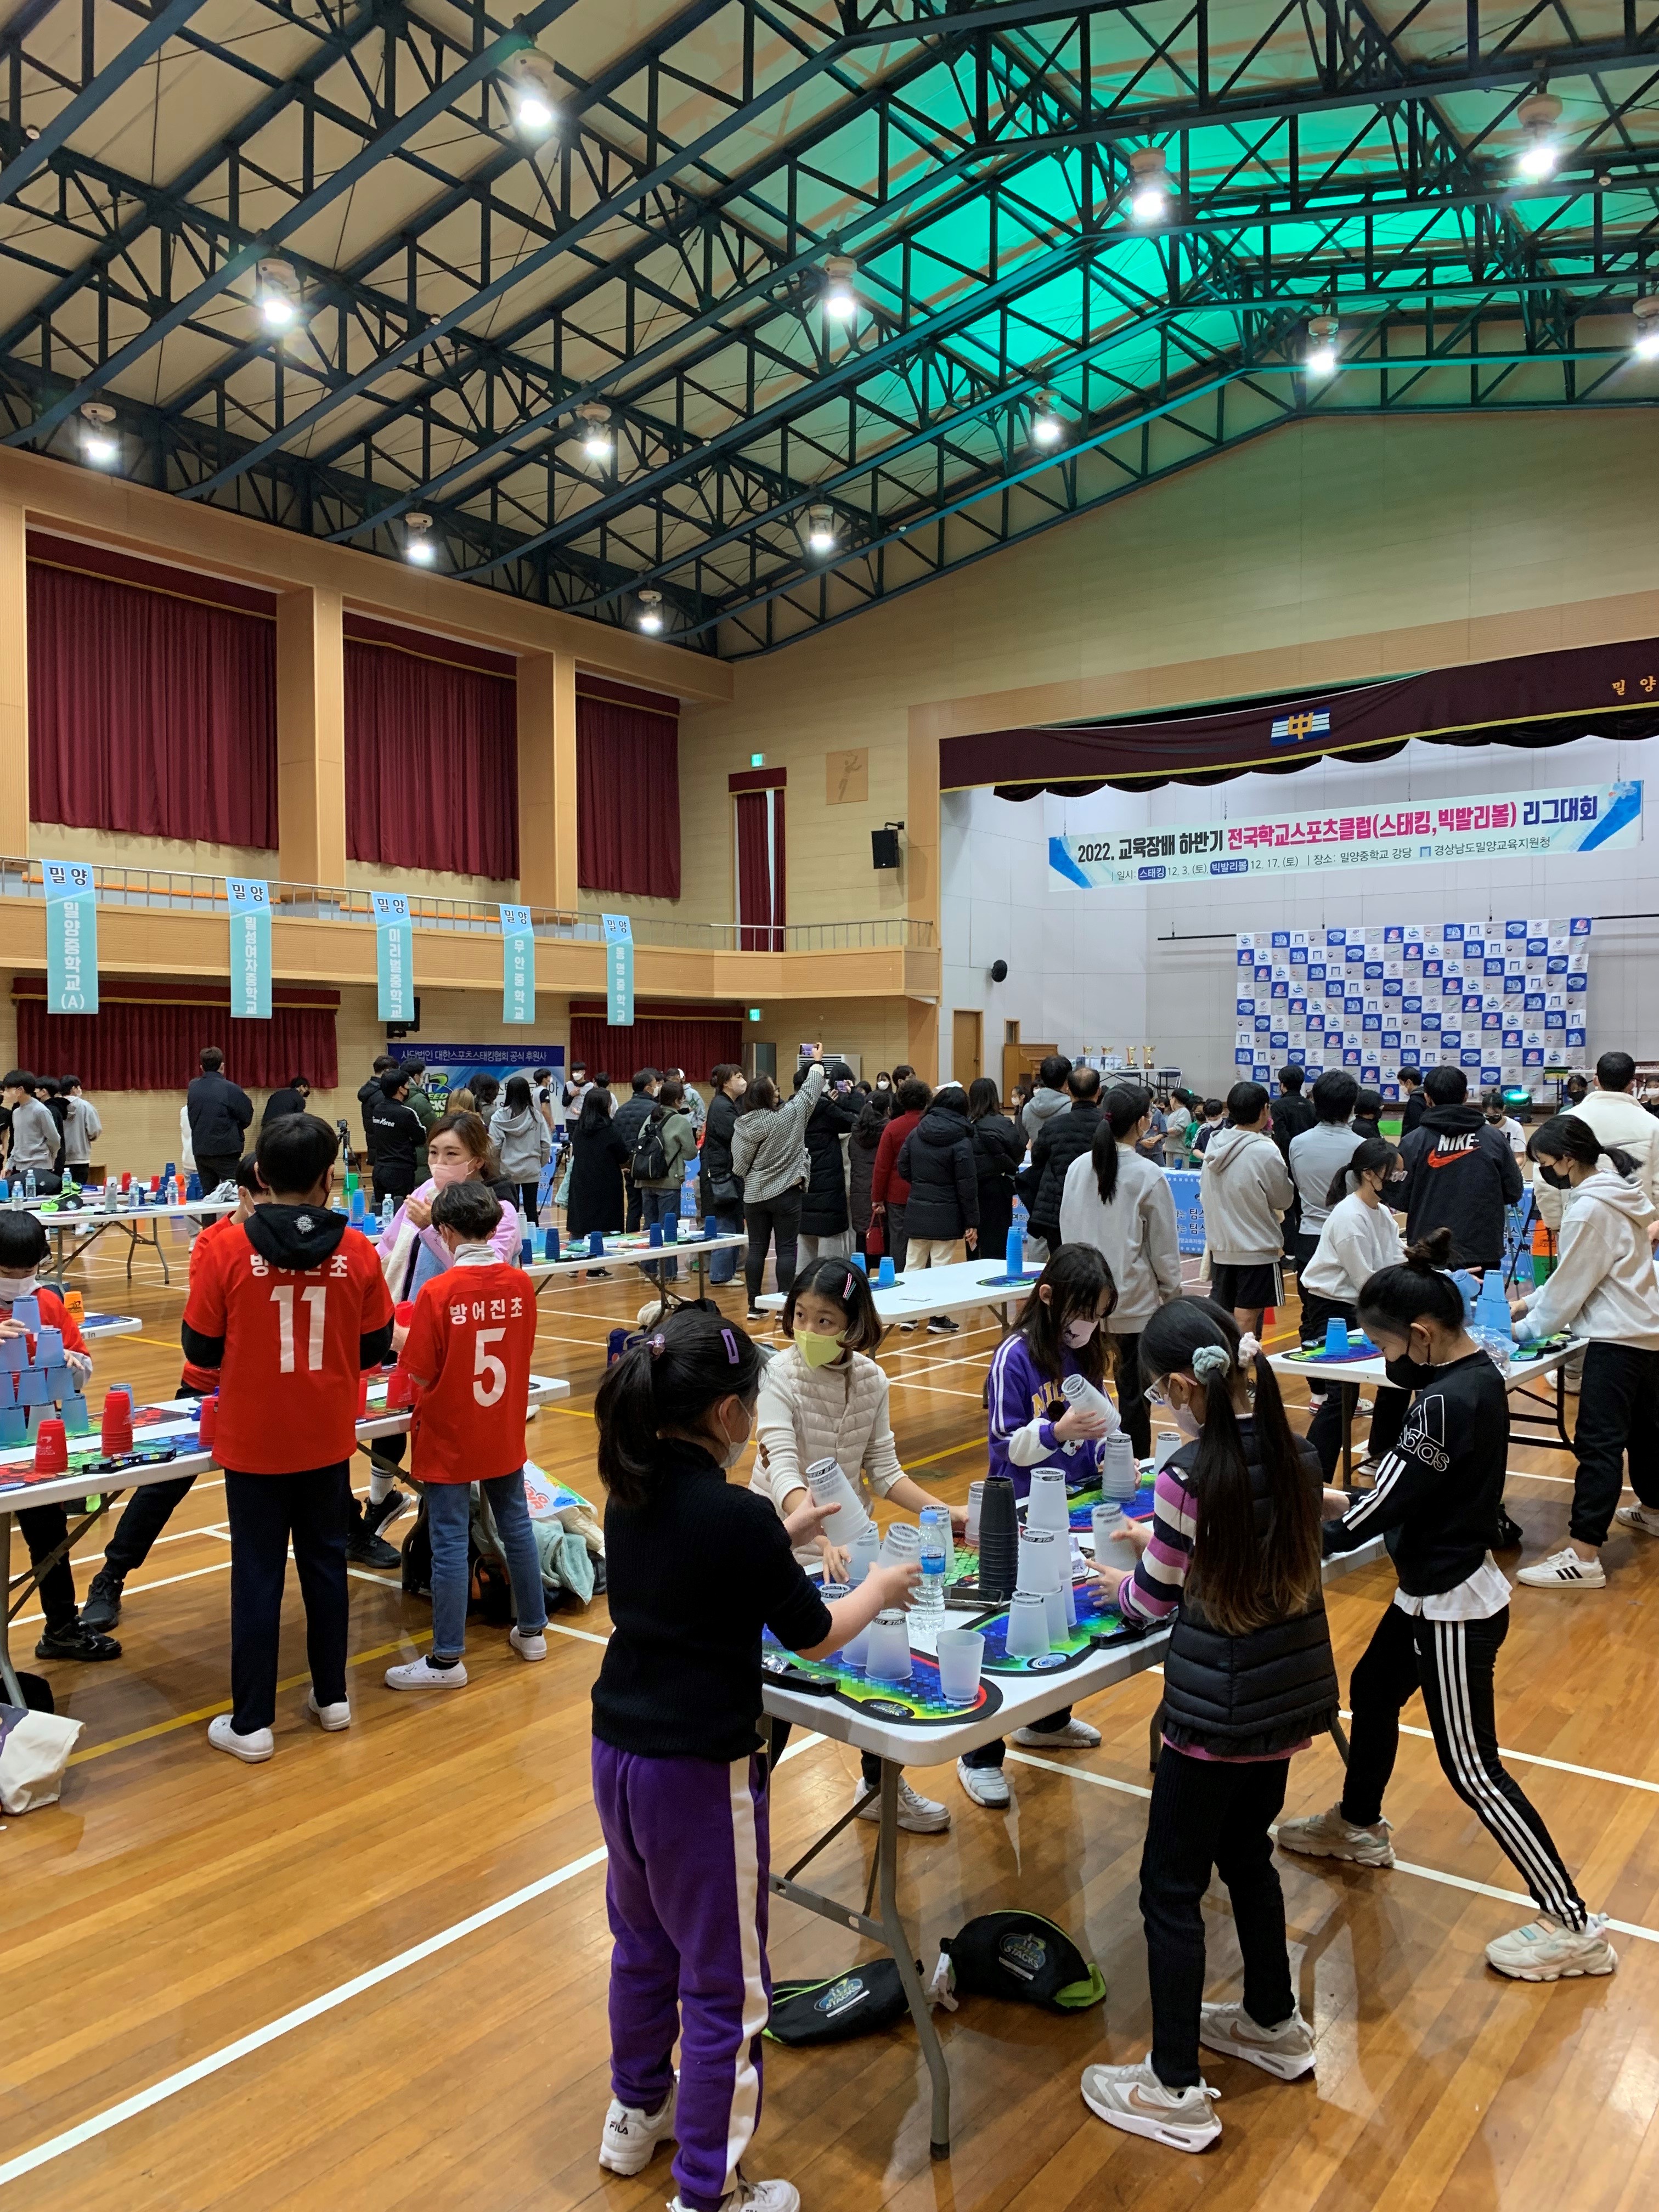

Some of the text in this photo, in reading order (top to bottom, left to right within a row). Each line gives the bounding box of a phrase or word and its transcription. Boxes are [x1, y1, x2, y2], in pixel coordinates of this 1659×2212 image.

[1077, 842, 1115, 863] 2022.
[1119, 834, 1175, 860] 교육장배
[1179, 830, 1223, 854] 하반기
[1523, 795, 1598, 826] 리그대회
[1117, 870, 1136, 881] 일시:
[1139, 867, 1165, 879] 스태킹
[1167, 866, 1180, 876] 12.
[1182, 866, 1190, 875] 3.
[1211, 860, 1248, 873] 빅발리볼
[1250, 859, 1263, 870] 12.
[1267, 858, 1280, 868] 17.
[1283, 856, 1299, 868] (토)
[1313, 853, 1336, 866] 장소:
[1340, 849, 1389, 863] 밀양중학교
[1392, 847, 1413, 859] 강당
[1434, 836, 1551, 856] 경상남도밀양교육지원청
[48, 866, 88, 886] 밀양
[232, 884, 264, 902] 밀양
[377, 898, 406, 914] 밀양
[504, 910, 528, 924] 밀양
[606, 919, 627, 933] 밀양
[514, 939, 525, 1020] 무안중학교
[435, 1049, 509, 1062] 대한스포츠스태킹협회
[510, 1051, 524, 1062] 공식
[525, 1051, 547, 1062] 후원사
[1437, 1133, 1476, 1152] NIKE
[250, 1254, 348, 1278] 방초
[449, 1296, 522, 1325] 방어진초
[269, 1284, 327, 1374] 11
[472, 1327, 507, 1408] 5
[609, 2120, 629, 2135] FILA
